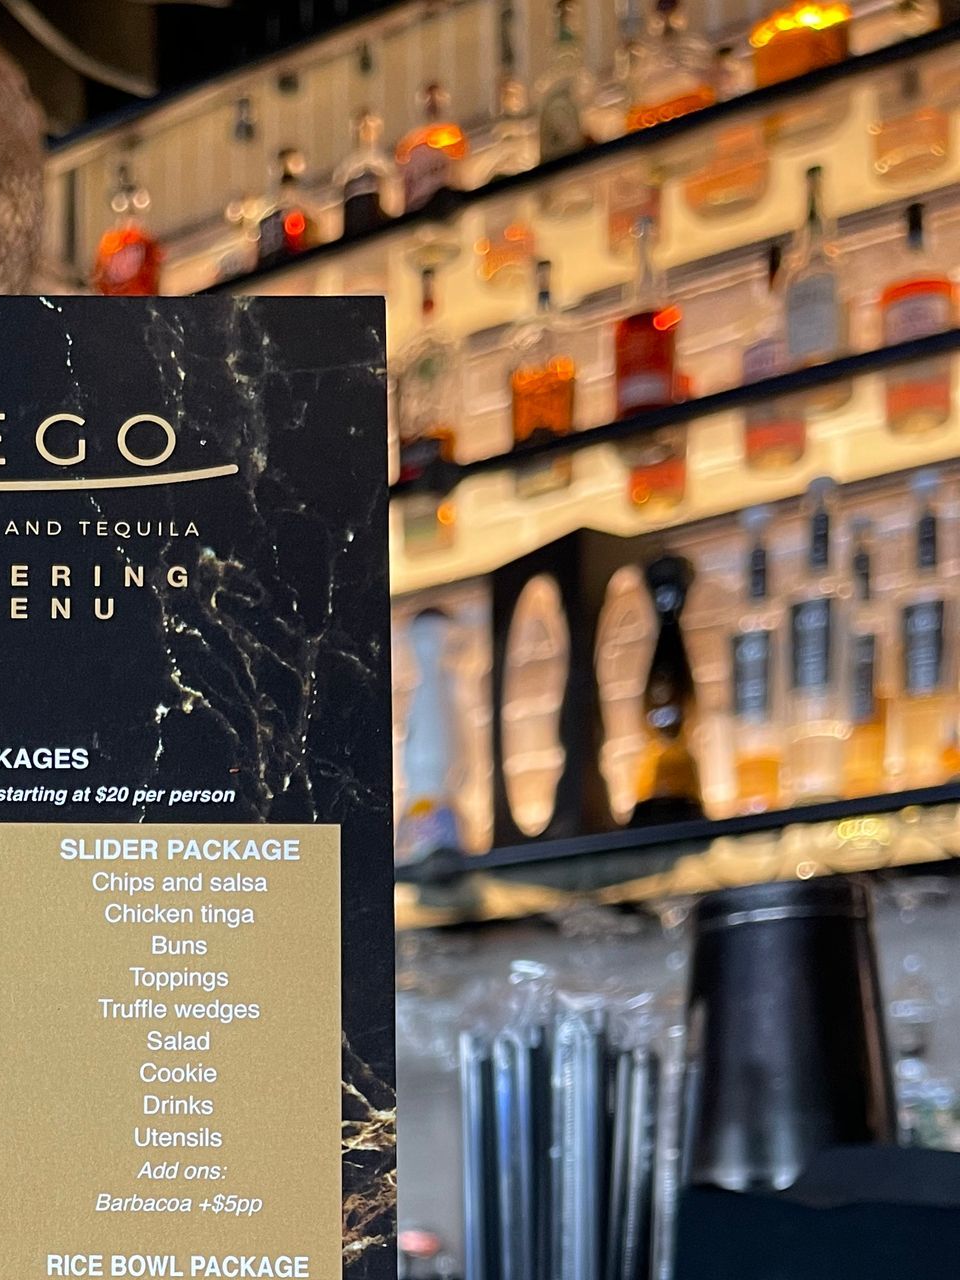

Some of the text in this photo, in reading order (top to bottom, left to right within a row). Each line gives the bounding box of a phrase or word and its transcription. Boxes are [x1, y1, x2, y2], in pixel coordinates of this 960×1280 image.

[5, 520, 63, 536] AND
[79, 520, 201, 537] TEQUILA
[73, 785, 90, 803] at
[95, 784, 128, 804] $20
[132, 788, 163, 806] per
[168, 788, 235, 806] person
[60, 839, 299, 860] SLIDER PACKAGE
[93, 872, 267, 895] Chips and salsa
[105, 904, 254, 928] Chicken tinga
[152, 936, 207, 954] Buns
[129, 967, 228, 991] Toppings
[98, 999, 259, 1023] Truffle wedges
[147, 1031, 209, 1050] Salad
[140, 1063, 216, 1082] Cookie
[144, 1095, 213, 1114] Drinks
[135, 1128, 222, 1147] Utensils
[137, 1162, 226, 1179] Add ons:
[96, 1194, 263, 1216] Barbacoa +$5pp
[48, 1255, 309, 1277] RICE BOWL PACKAGE
